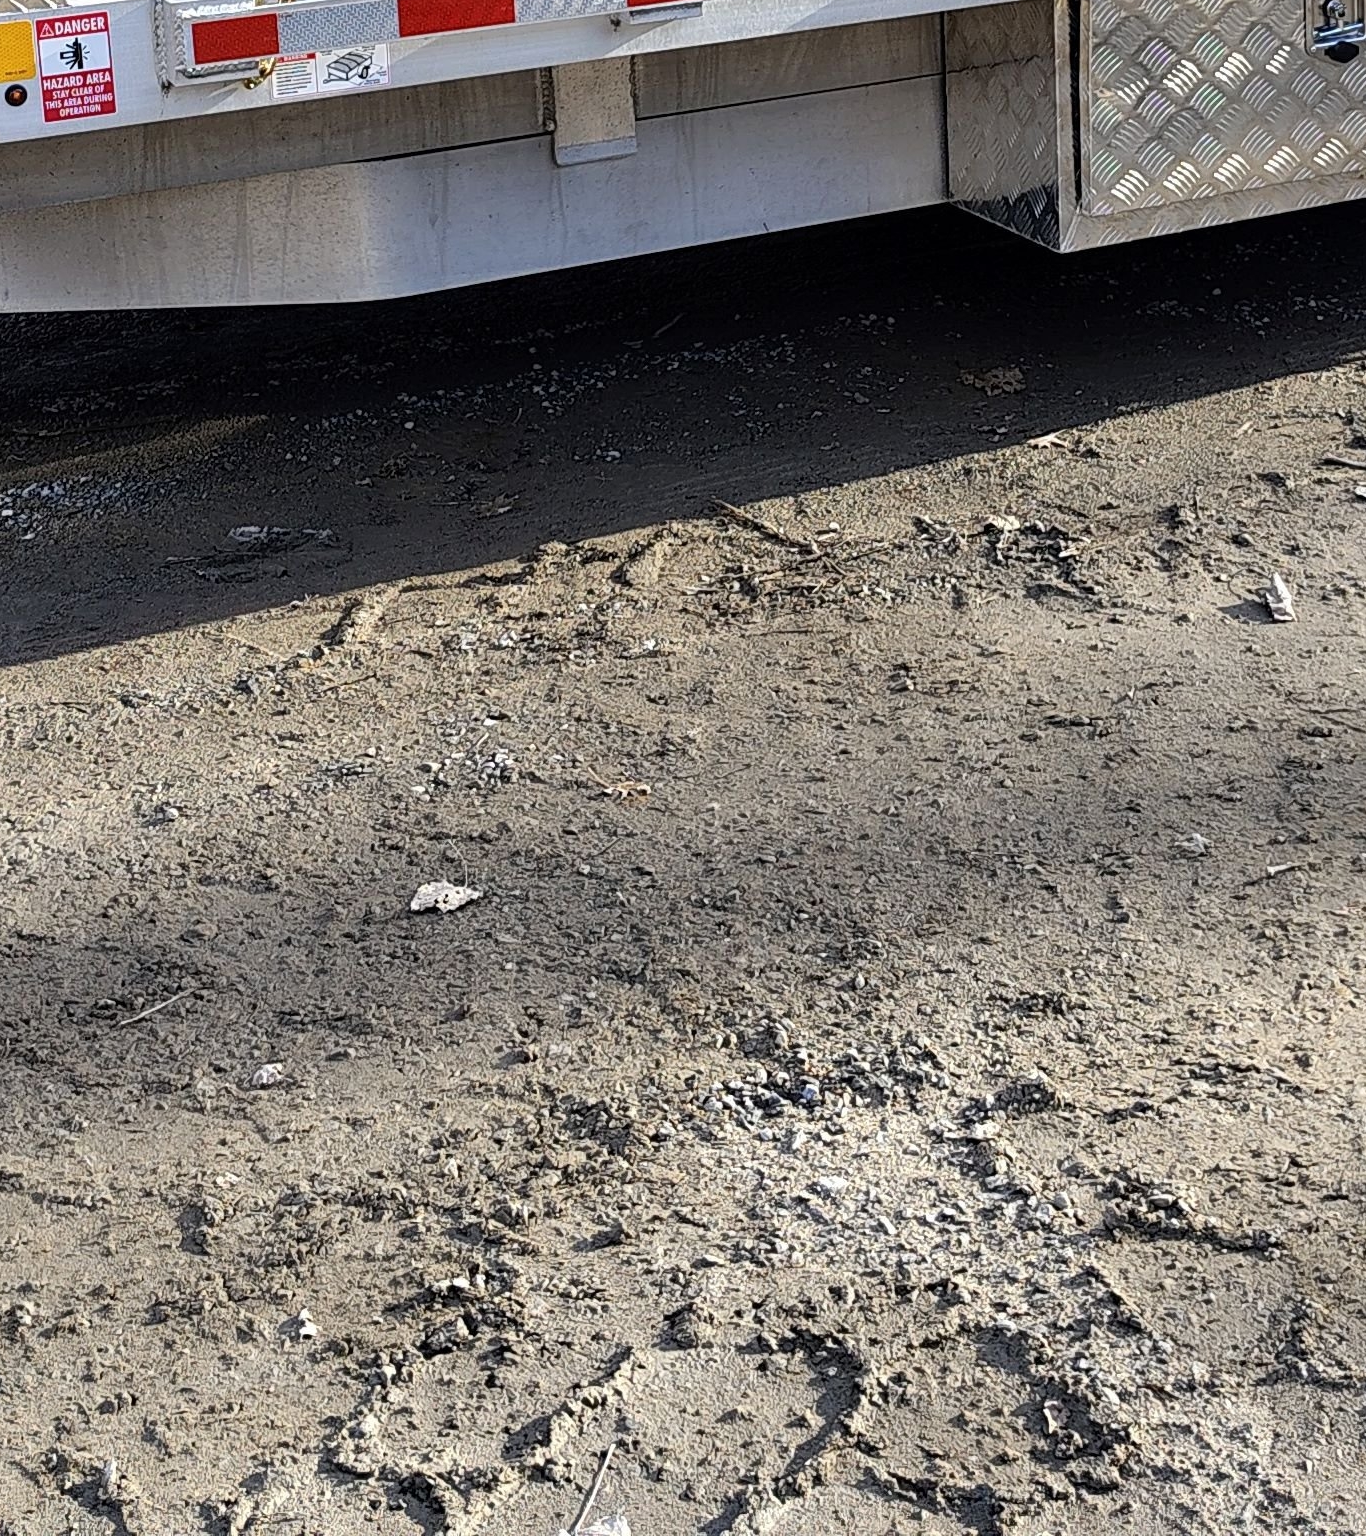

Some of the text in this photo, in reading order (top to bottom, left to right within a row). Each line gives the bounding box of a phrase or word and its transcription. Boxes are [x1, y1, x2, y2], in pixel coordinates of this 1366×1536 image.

[55, 17, 105, 35] DANGER
[43, 71, 111, 91] HAZARD AREA
[53, 84, 104, 99] STAY CLEAR OF
[45, 92, 113, 110] THIS AREA DURING
[59, 104, 101, 117] OPERATION
